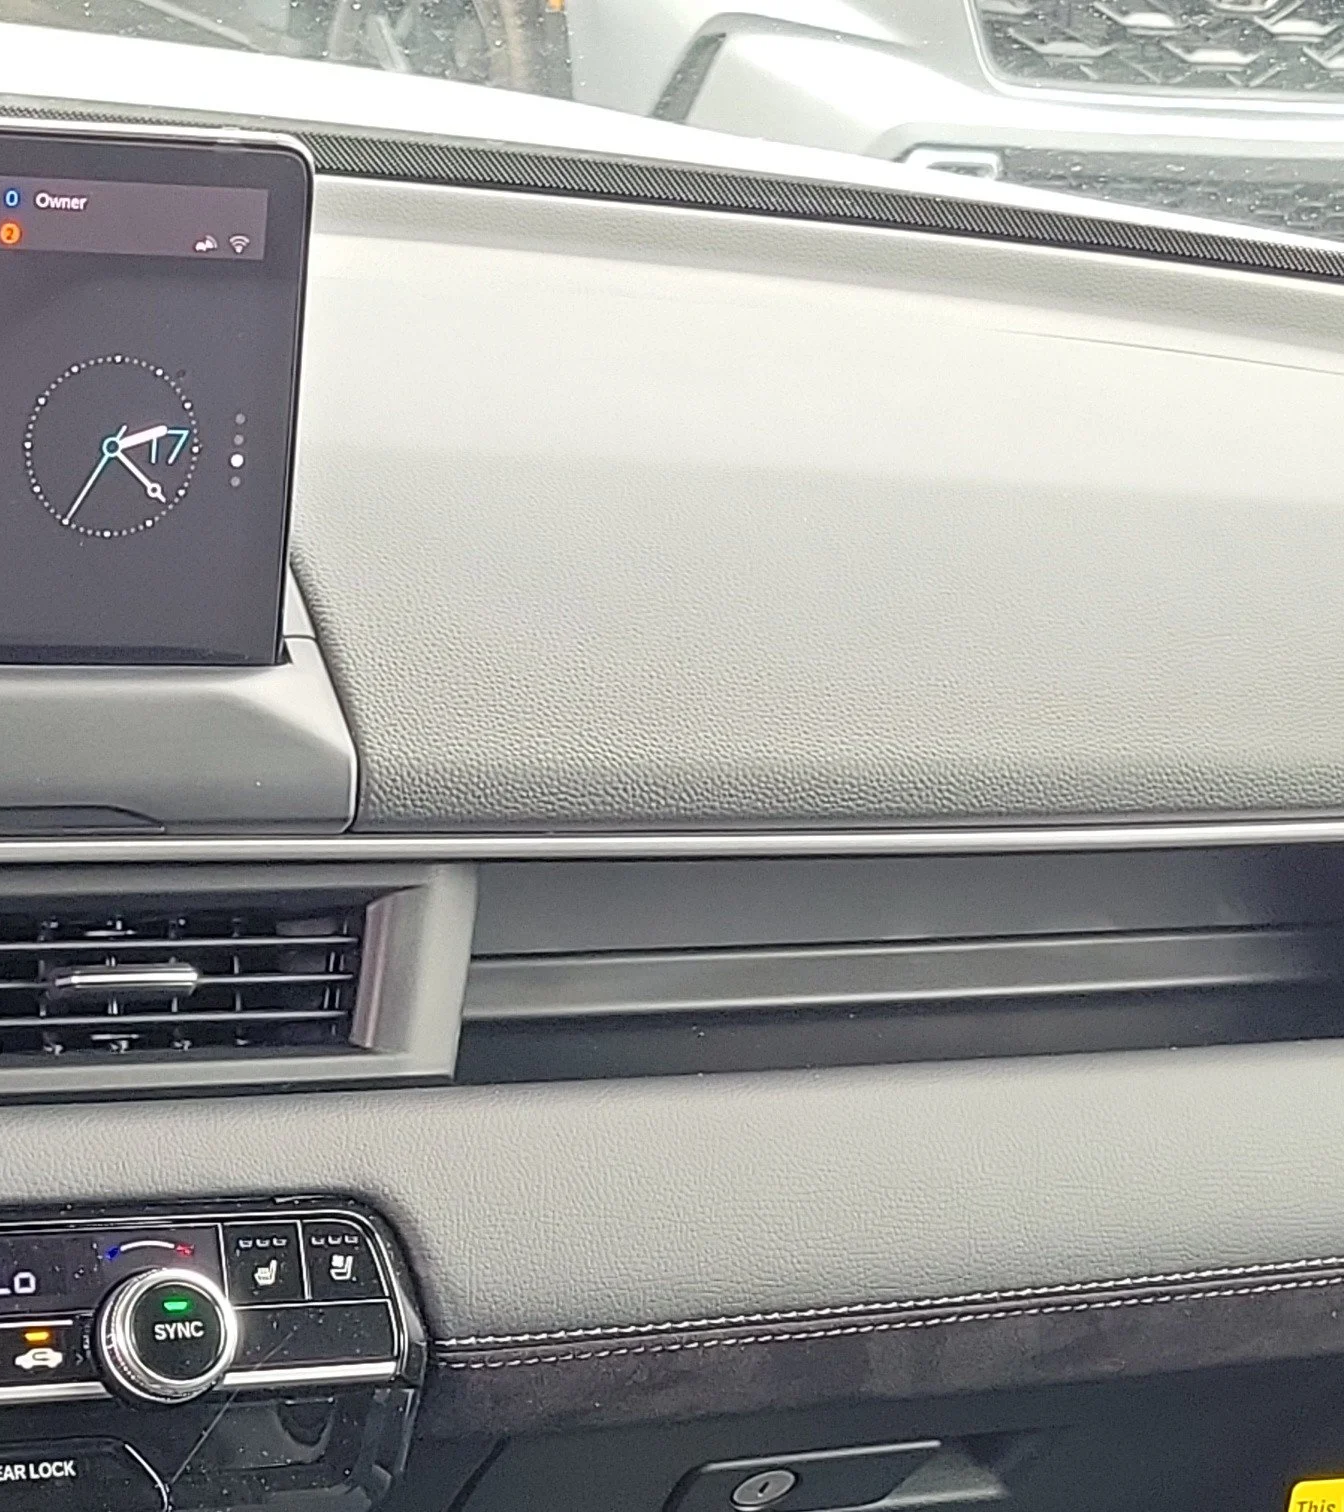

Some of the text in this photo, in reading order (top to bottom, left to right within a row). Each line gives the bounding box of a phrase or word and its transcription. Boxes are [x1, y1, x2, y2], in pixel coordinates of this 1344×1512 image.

[36, 192, 88, 211] Owner
[154, 1321, 204, 1341] SYNC
[26, 1461, 76, 1480] LOCK
